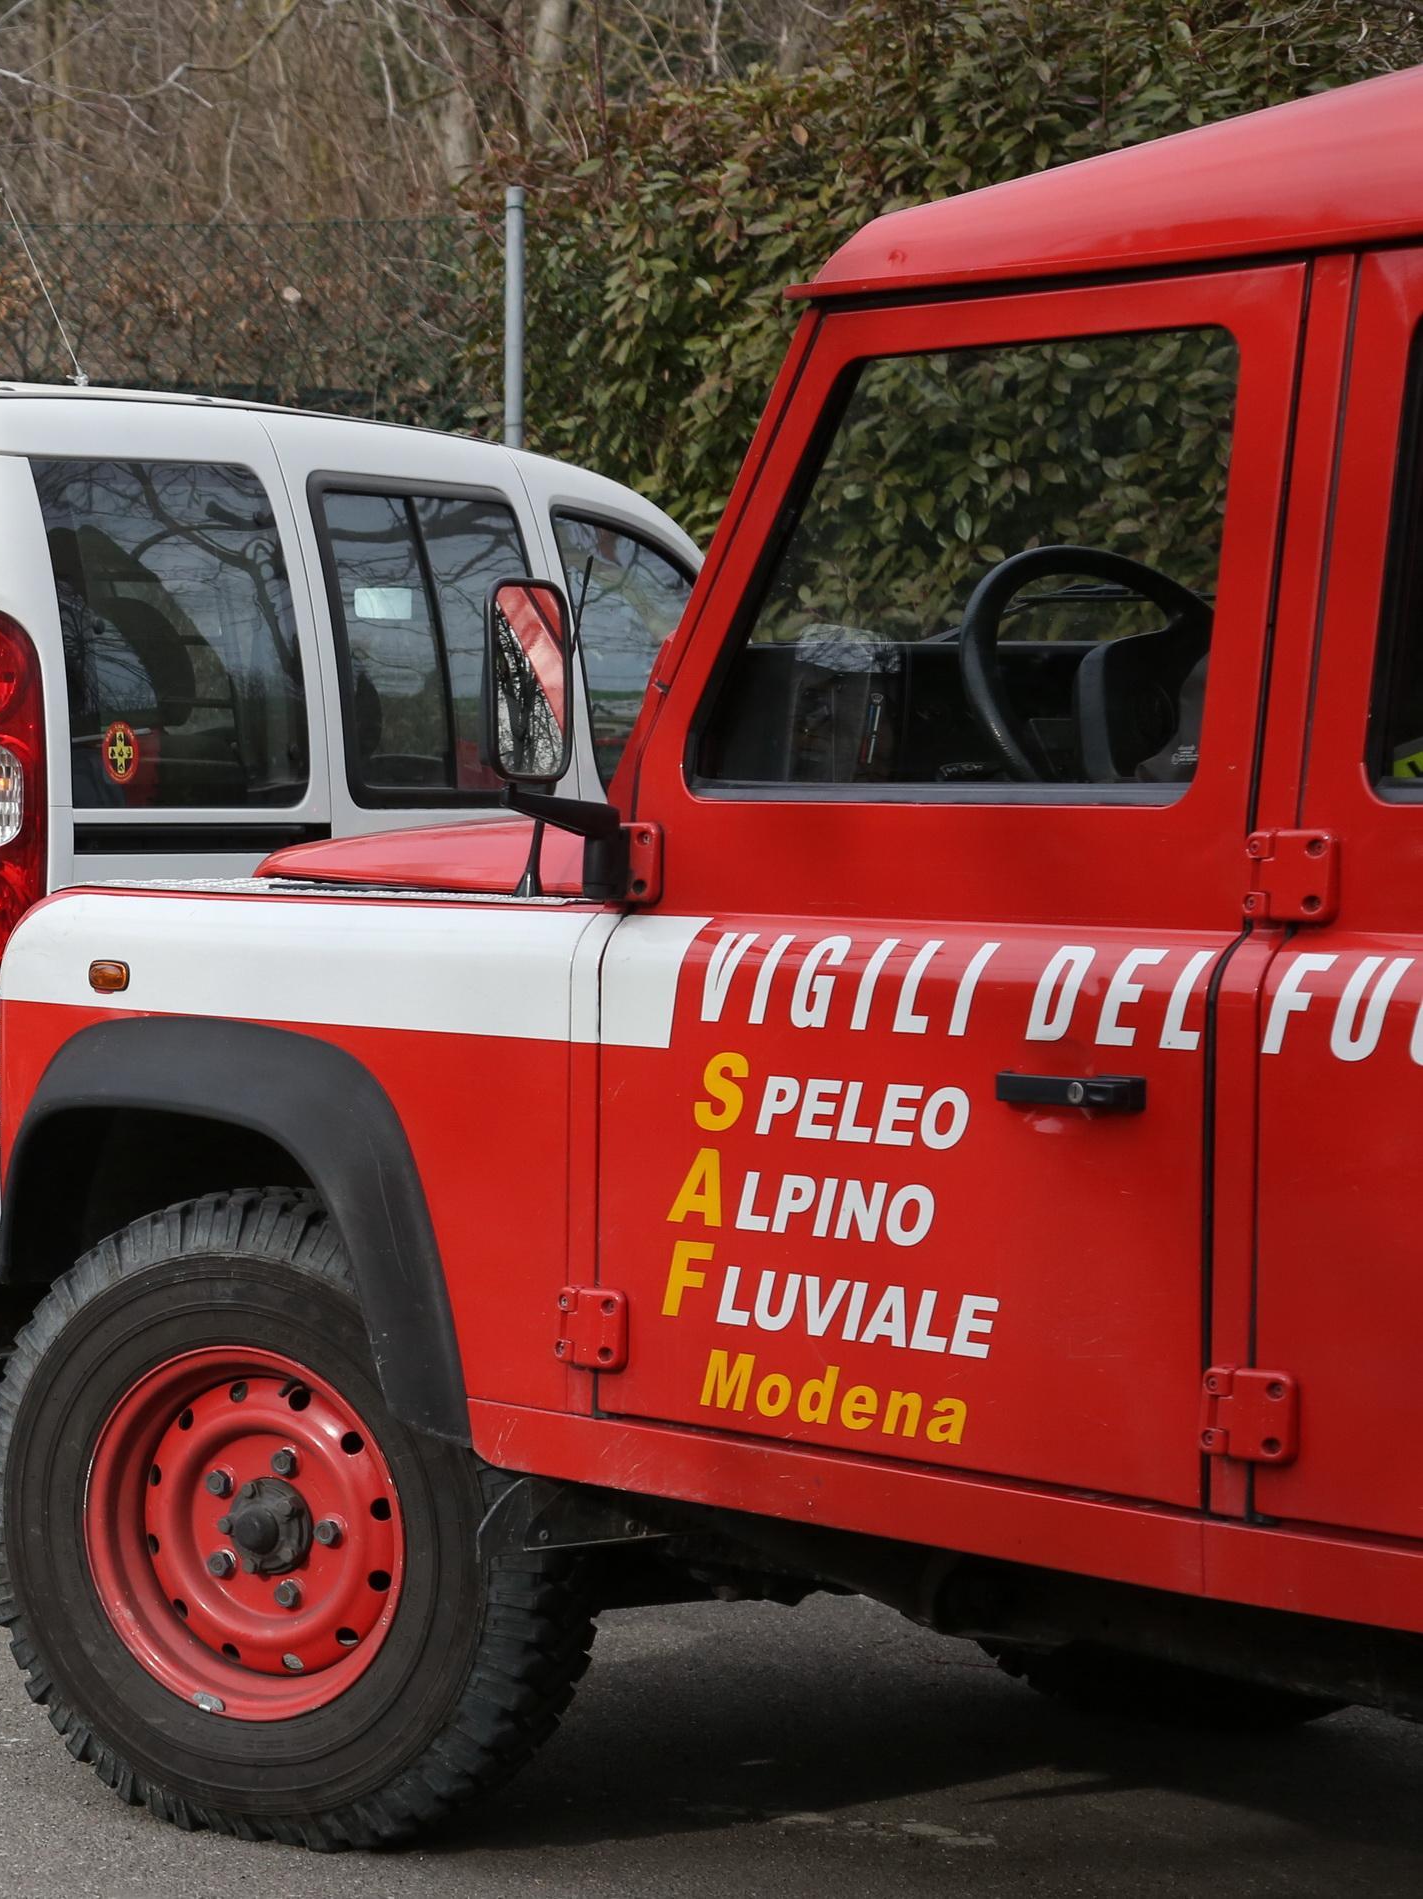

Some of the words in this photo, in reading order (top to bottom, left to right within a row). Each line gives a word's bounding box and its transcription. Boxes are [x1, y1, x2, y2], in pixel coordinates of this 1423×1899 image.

[700, 932, 1002, 1036] VIGILI
[1025, 945, 1217, 1050] DEL
[1260, 953, 1423, 1066] FU
[699, 1349, 968, 1445] Modena
